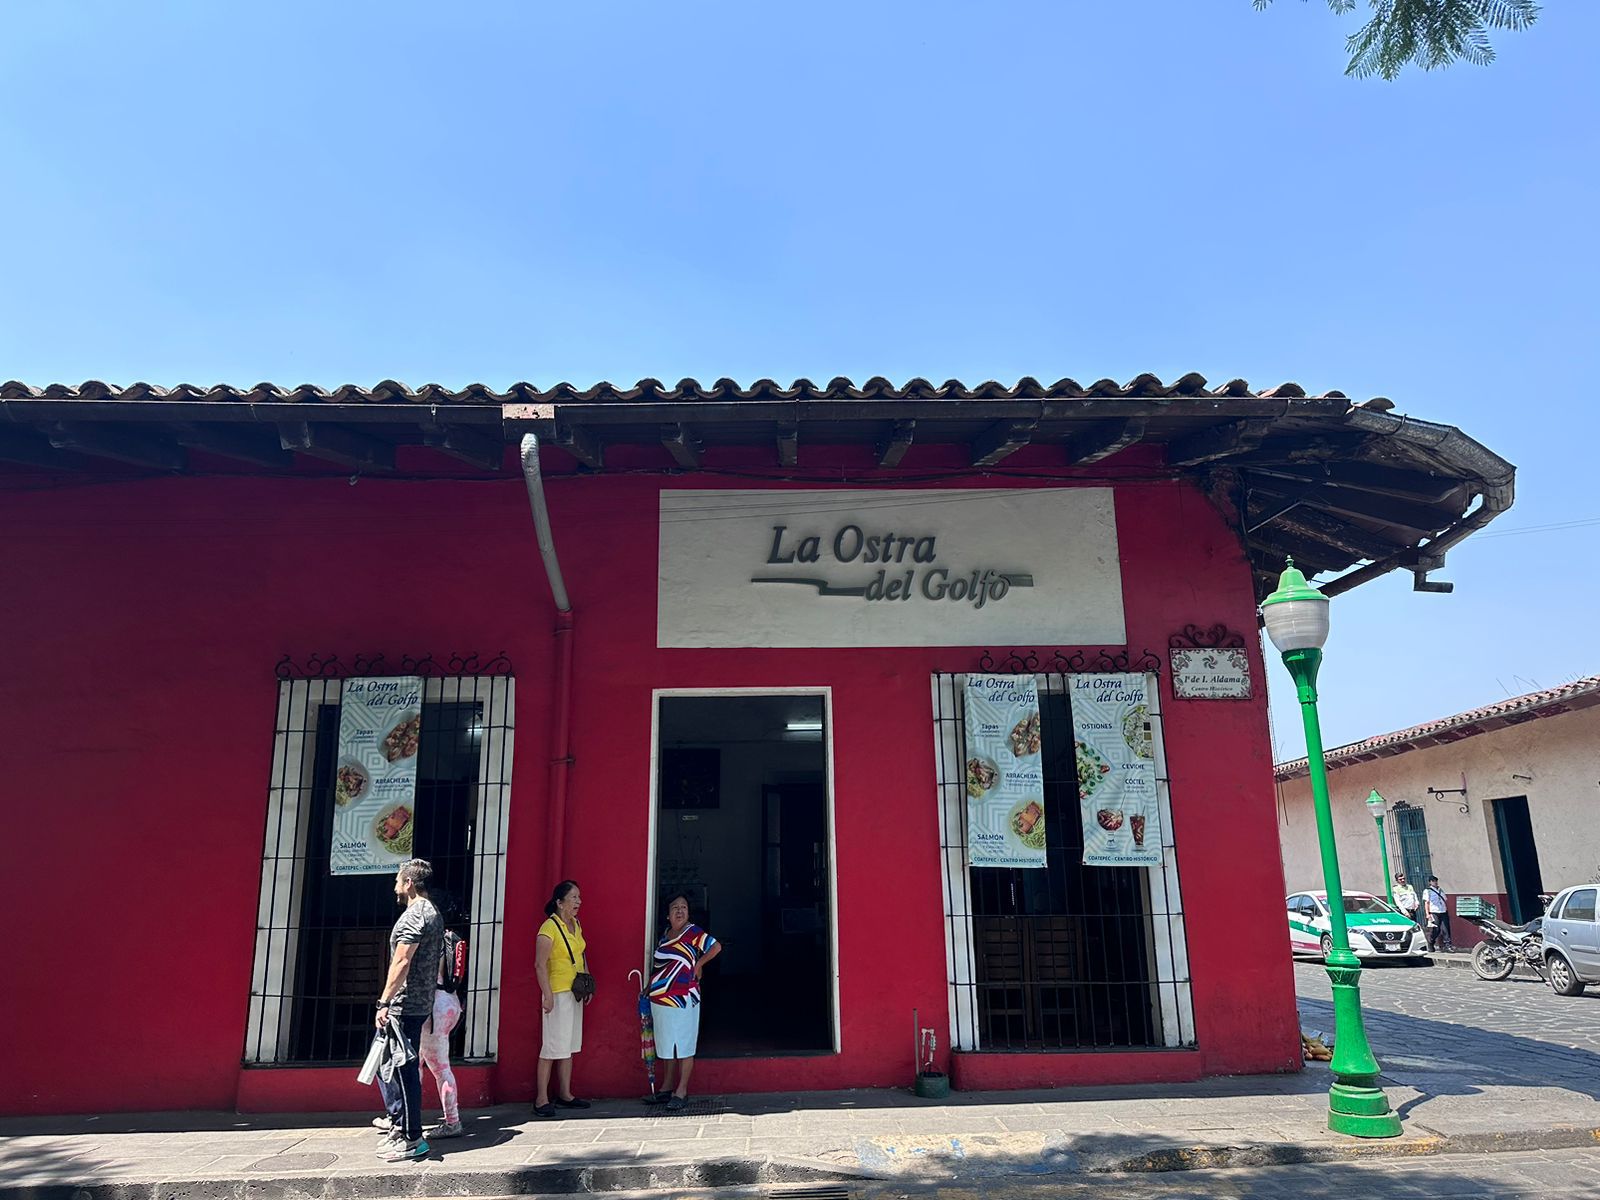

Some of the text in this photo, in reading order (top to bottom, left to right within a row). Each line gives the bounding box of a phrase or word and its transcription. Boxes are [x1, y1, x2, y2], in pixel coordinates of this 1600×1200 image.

[767, 524, 937, 564] La Ostra
[864, 568, 1011, 609] del Golfo
[968, 677, 1014, 689] La Ostra
[1076, 678, 1122, 689] La Ostra
[1191, 675, 1200, 683] de
[1211, 675, 1241, 683] Aldama
[346, 680, 398, 692] La Ostra
[366, 692, 418, 711] del Golfo
[989, 690, 1035, 707] del Golfo
[1096, 689, 1144, 706] del Golfo
[977, 833, 1004, 841] SALMÓN
[339, 841, 367, 849] SALMÓN
